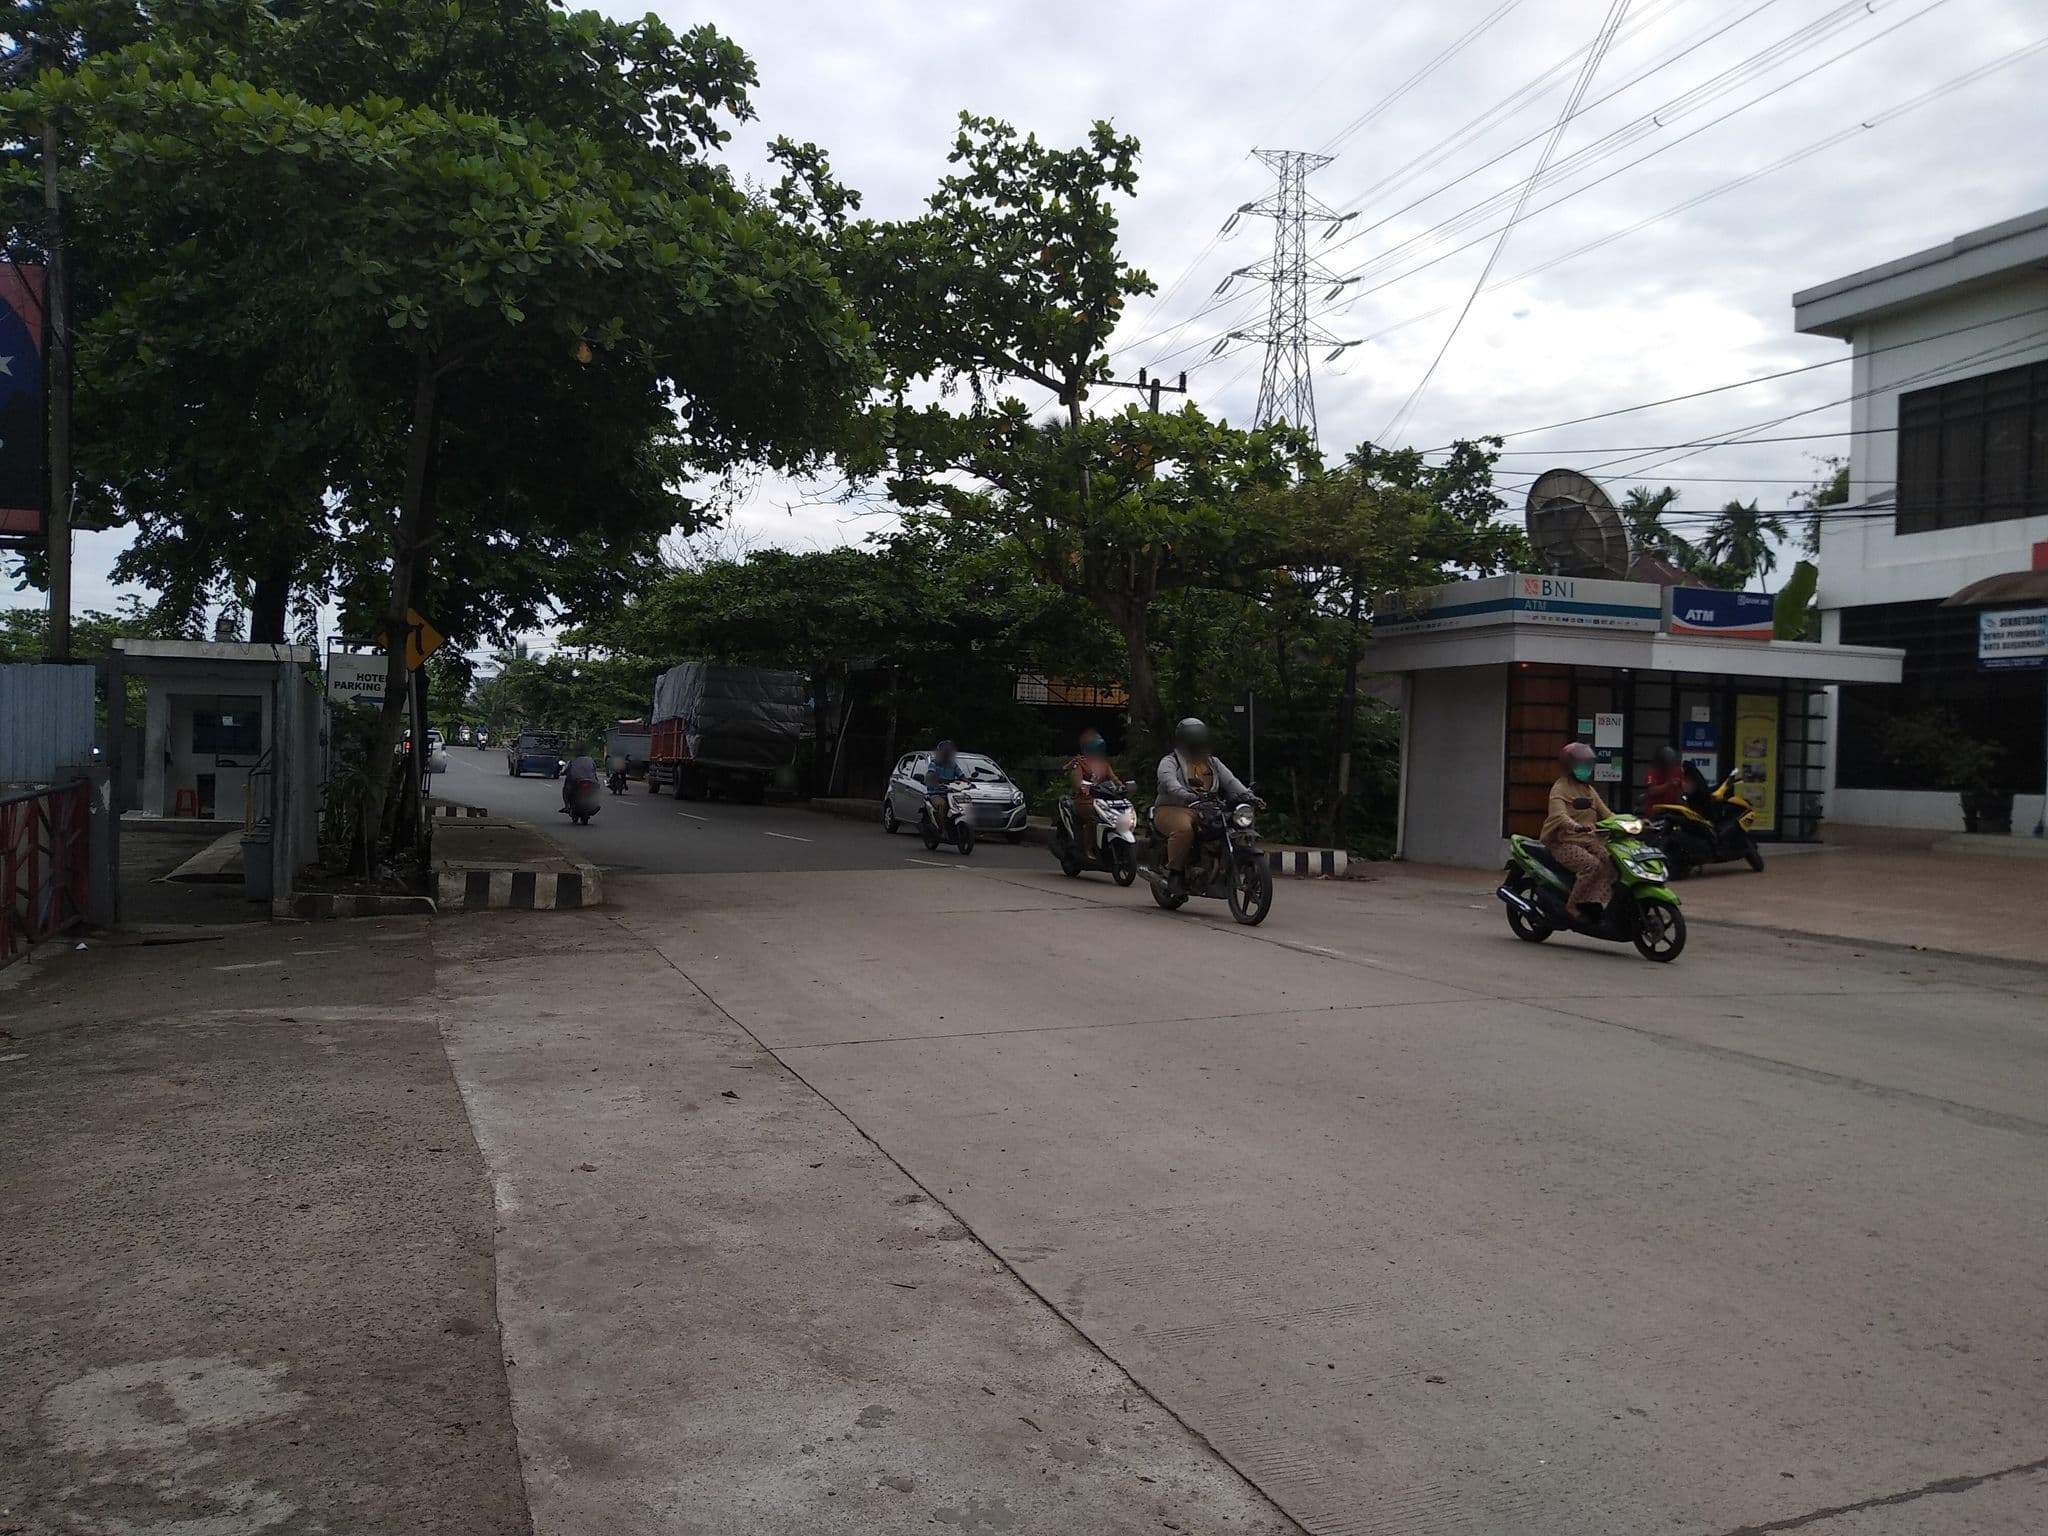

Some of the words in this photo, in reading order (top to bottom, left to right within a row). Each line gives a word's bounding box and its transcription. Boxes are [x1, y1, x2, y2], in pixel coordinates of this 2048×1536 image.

[1542, 579, 1574, 598] BNI
[1524, 600, 1547, 611] ATM
[1685, 609, 1714, 622] ATM
[356, 673, 385, 683] HOTE
[334, 681, 381, 691] PARKING
[1606, 717, 1621, 726] BNI
